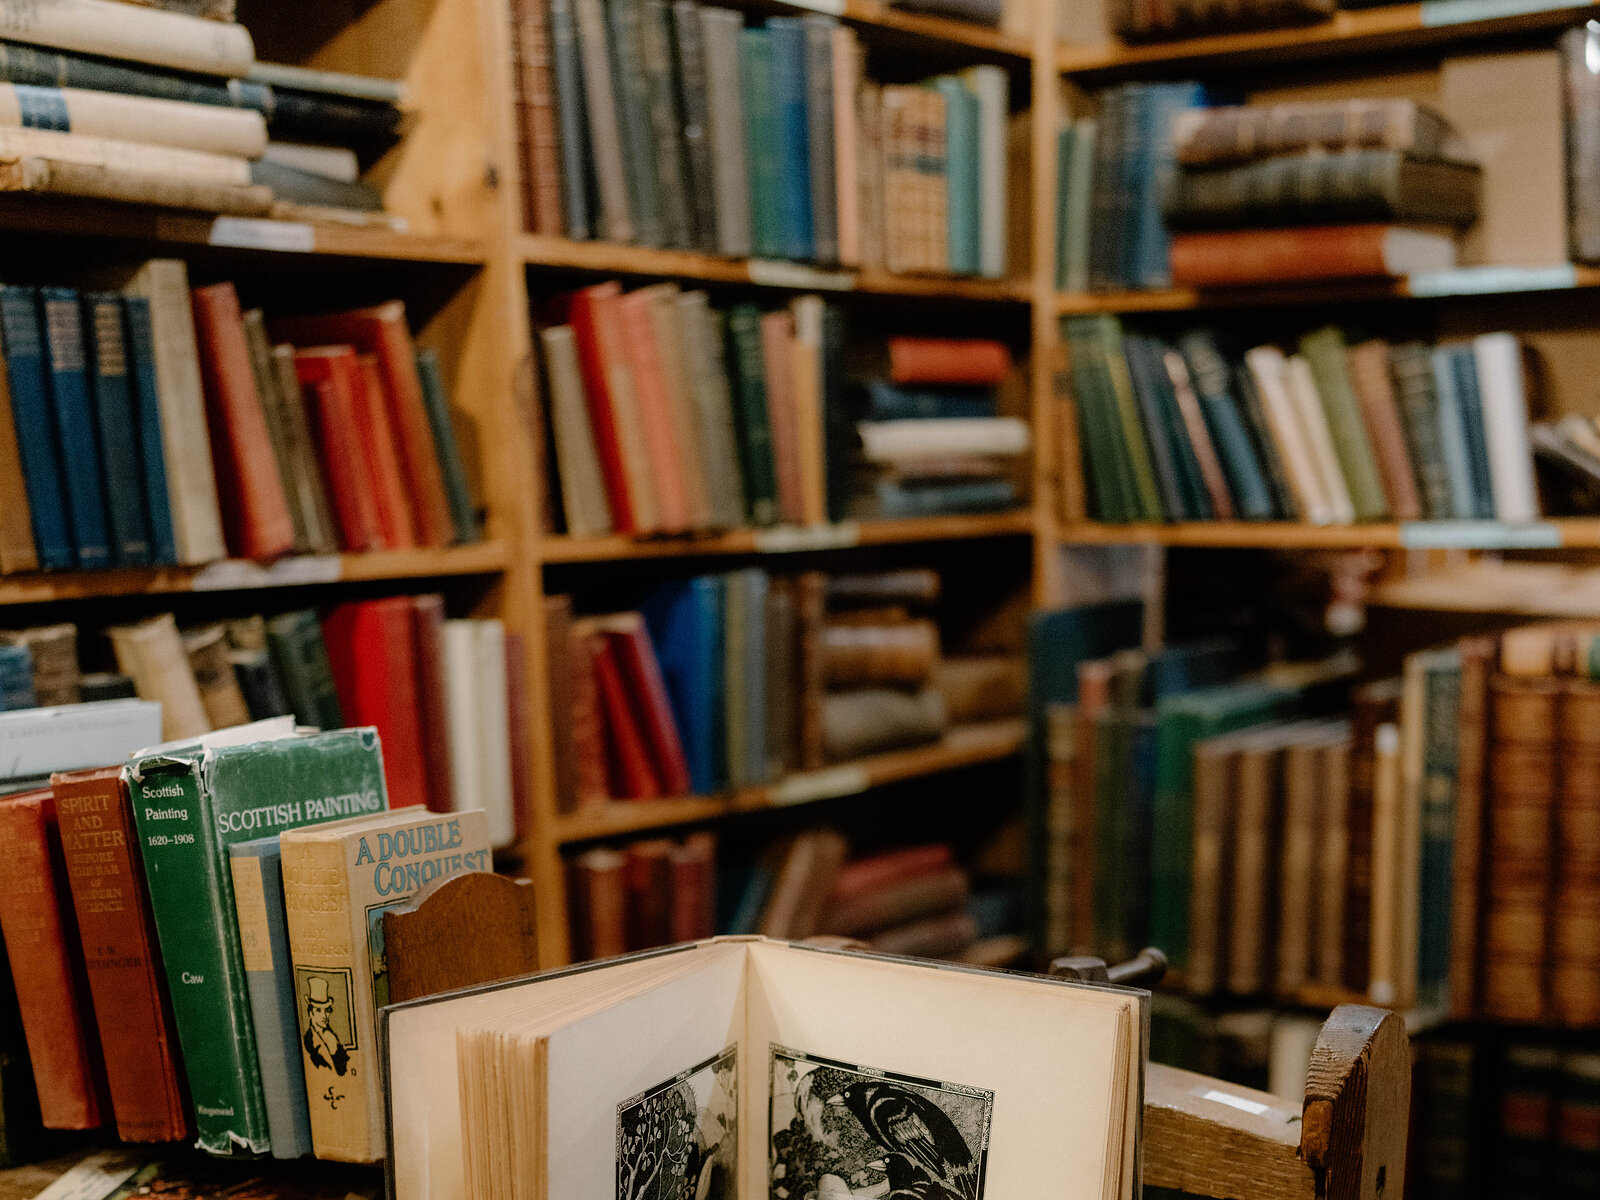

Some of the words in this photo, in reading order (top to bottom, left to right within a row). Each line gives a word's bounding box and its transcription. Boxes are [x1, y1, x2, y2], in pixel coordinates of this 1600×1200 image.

[142, 784, 184, 799] Scottish
[61, 794, 110, 814] SPIRIT
[218, 802, 301, 834] SCOTTISH
[304, 789, 380, 820] PAINTING
[73, 815, 103, 832] AND
[145, 808, 188, 822] Painting
[354, 836, 375, 866] A
[378, 819, 464, 862] DOUBLE
[181, 972, 204, 985] Caw
